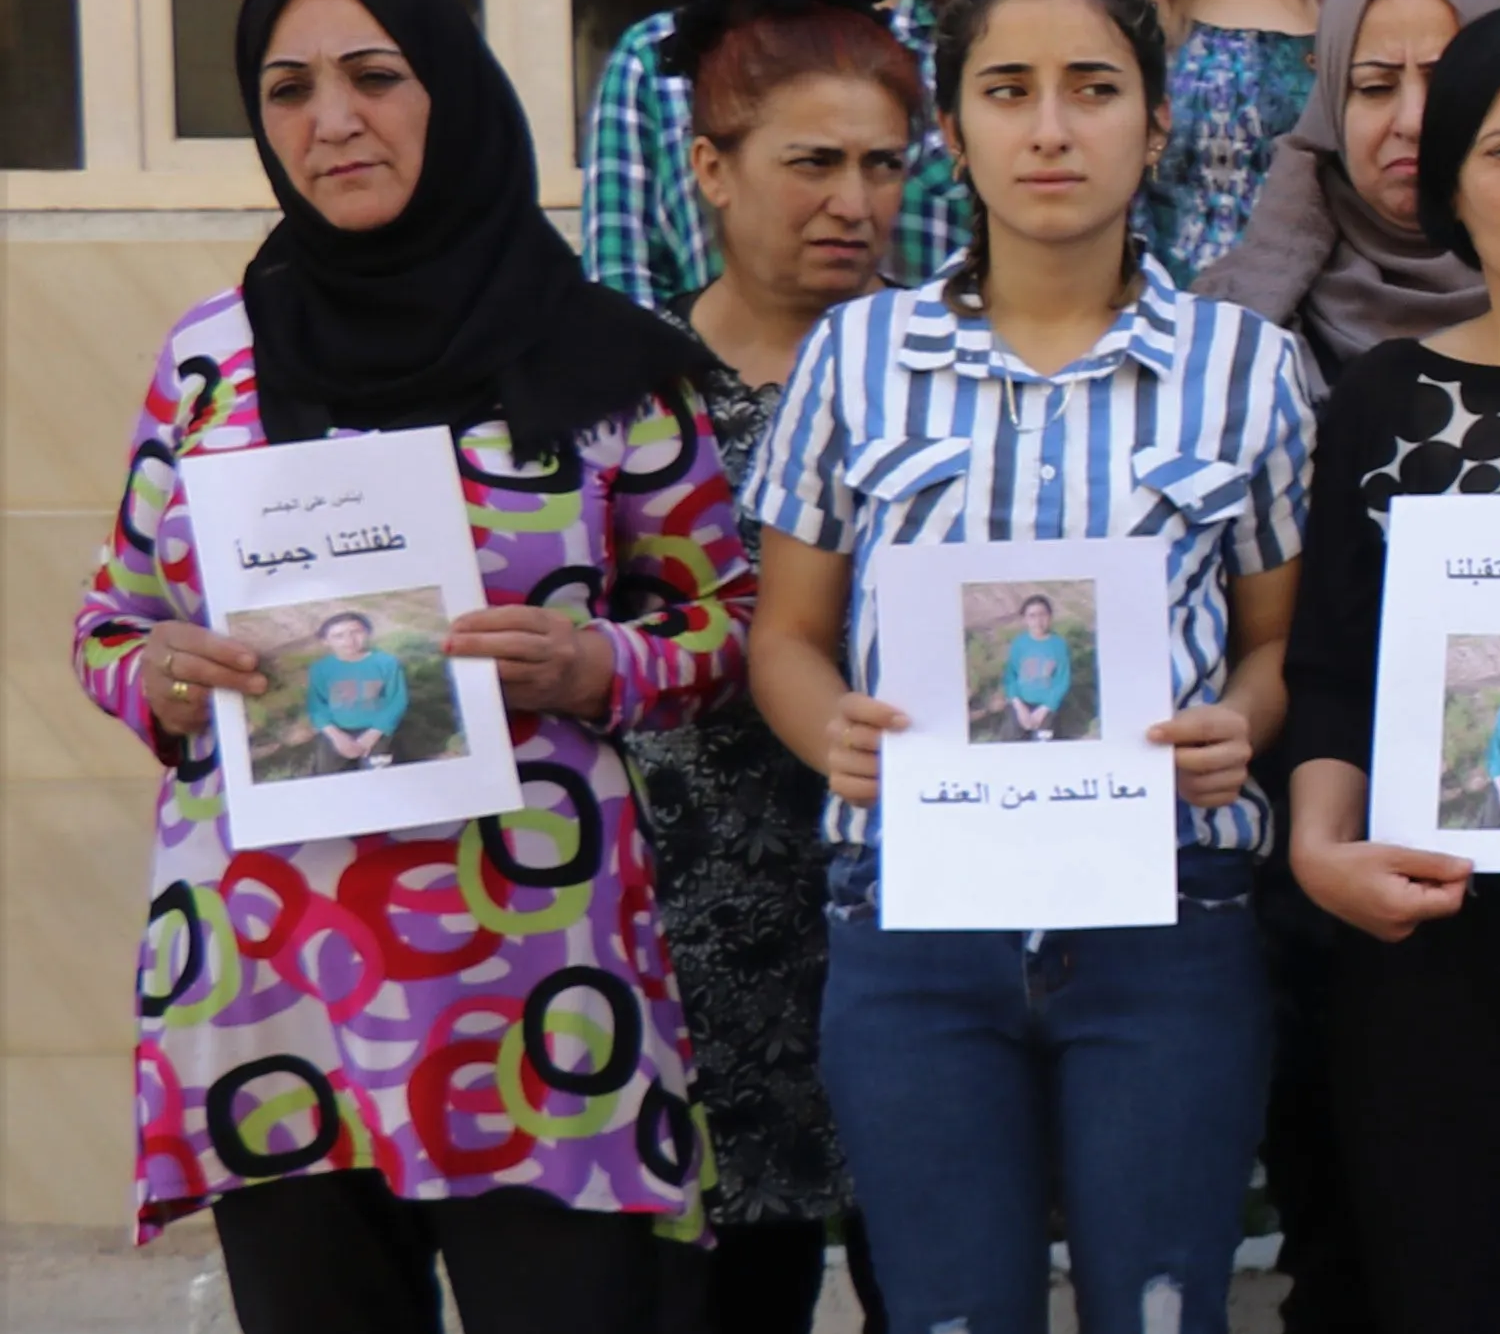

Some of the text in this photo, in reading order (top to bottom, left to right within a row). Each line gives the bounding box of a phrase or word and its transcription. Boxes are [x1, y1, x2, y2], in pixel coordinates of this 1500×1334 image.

[326, 524, 407, 557] طفلتنا
[919, 780, 990, 805] العنف
[1000, 786, 1037, 810] من
[1048, 778, 1098, 801] للحد
